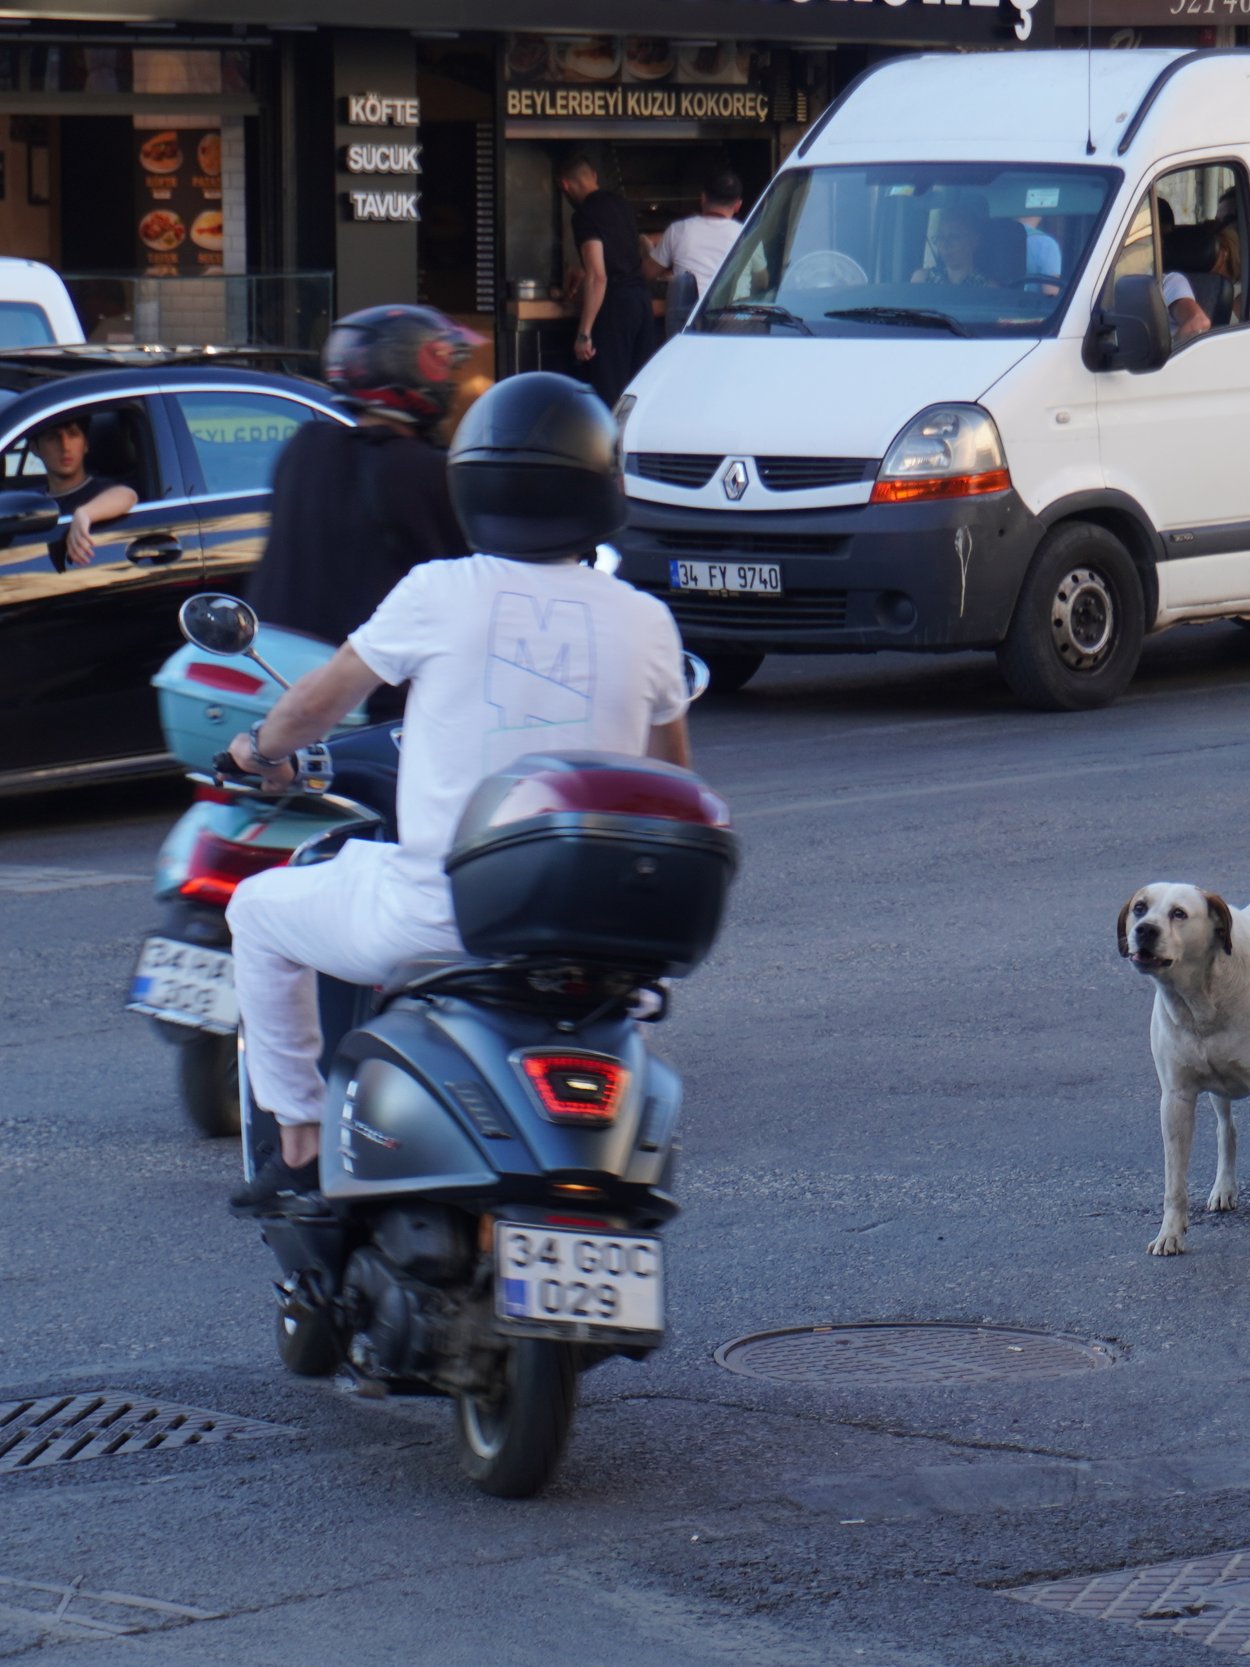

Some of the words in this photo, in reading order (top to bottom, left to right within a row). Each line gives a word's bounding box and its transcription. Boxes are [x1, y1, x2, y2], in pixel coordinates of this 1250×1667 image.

[348, 92, 420, 126] KÖFTE
[507, 87, 623, 116] BEYLERBEYİ
[627, 92, 676, 117] KUZU
[681, 92, 768, 122] KOKOREÇ
[347, 144, 422, 173] SUCUK
[350, 192, 421, 221] TAVUK
[679, 564, 699, 587] 34
[708, 565, 727, 588] FY
[737, 566, 779, 590] 9740
[144, 942, 188, 973] 34
[508, 1233, 562, 1268] 34
[539, 1278, 621, 1319] 029
